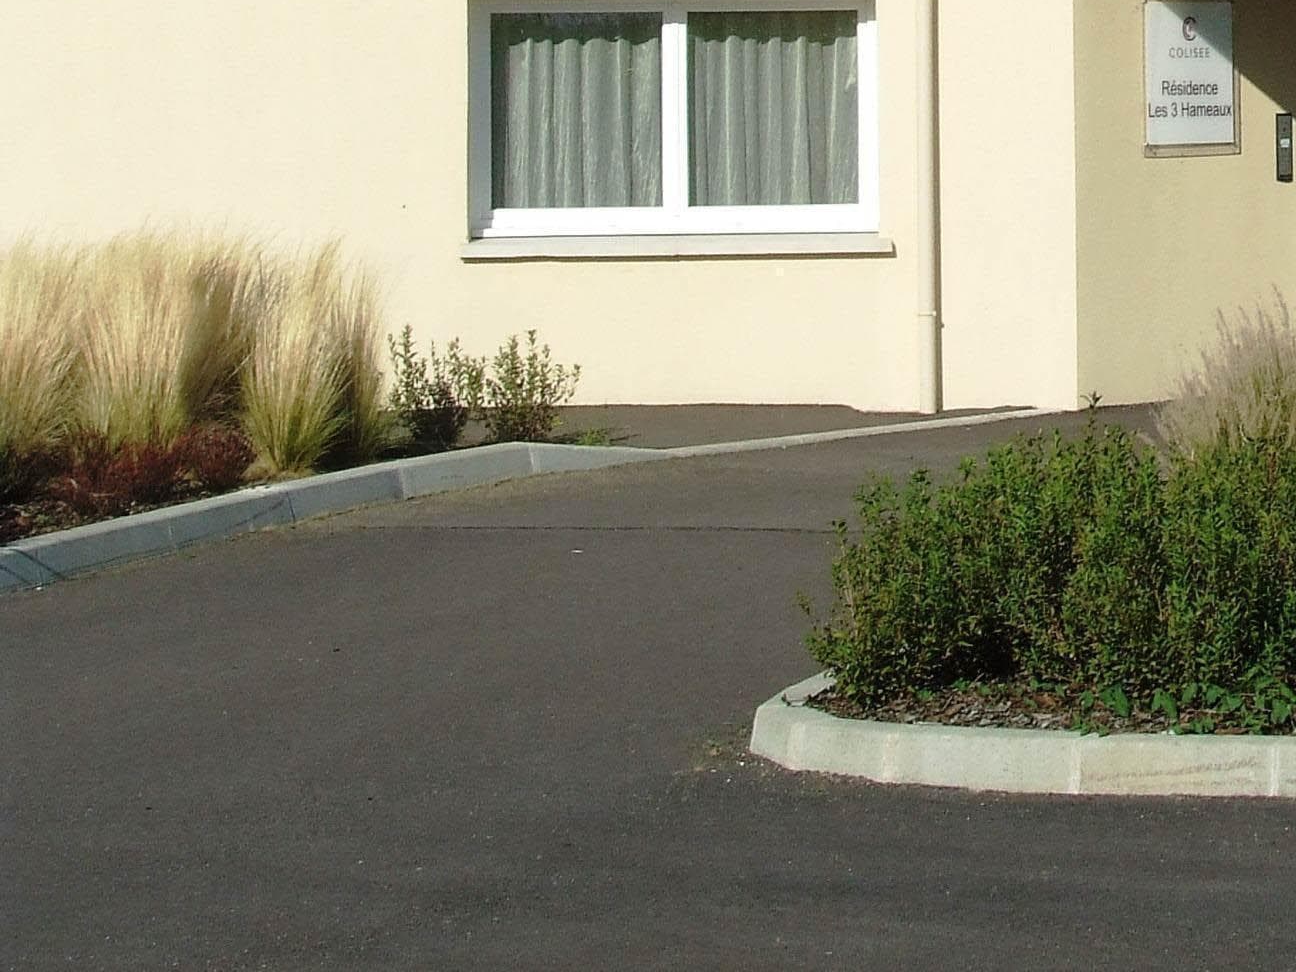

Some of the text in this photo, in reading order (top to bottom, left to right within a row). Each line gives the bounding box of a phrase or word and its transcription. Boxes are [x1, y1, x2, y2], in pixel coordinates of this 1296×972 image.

[1161, 79, 1219, 96] Résidence
[1148, 102, 1232, 118] Les 3 Hameaux
